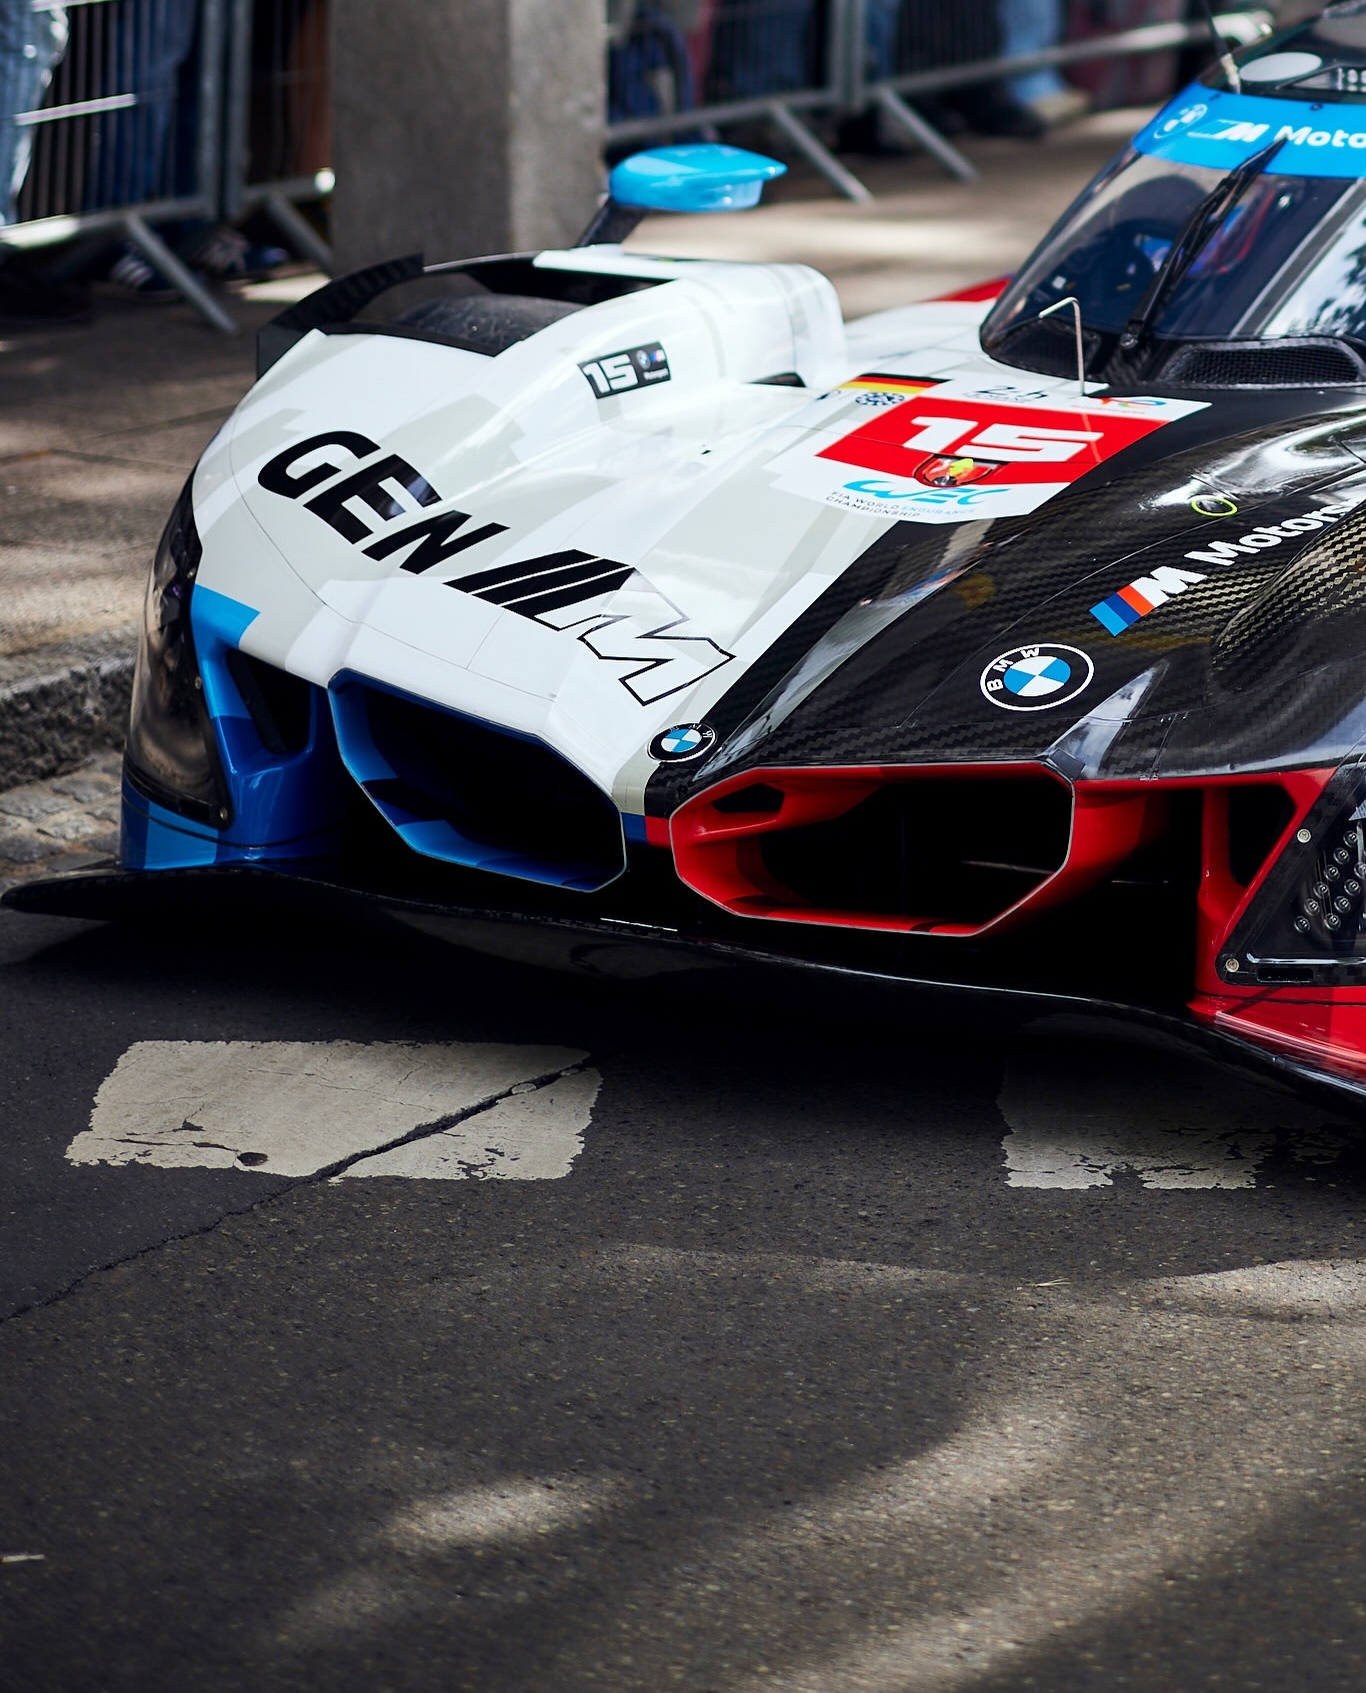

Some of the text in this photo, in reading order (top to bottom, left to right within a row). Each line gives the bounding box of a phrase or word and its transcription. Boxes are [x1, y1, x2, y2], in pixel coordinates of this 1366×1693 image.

[582, 353, 638, 393] 15
[902, 416, 1104, 463] 15
[258, 431, 511, 575] GEN
[826, 495, 921, 518] CHAMPIONSHIP
[831, 490, 850, 500] FIA
[856, 498, 900, 510] WORLD
[1184, 498, 1358, 566] Motors
[987, 647, 1040, 693] BMW
